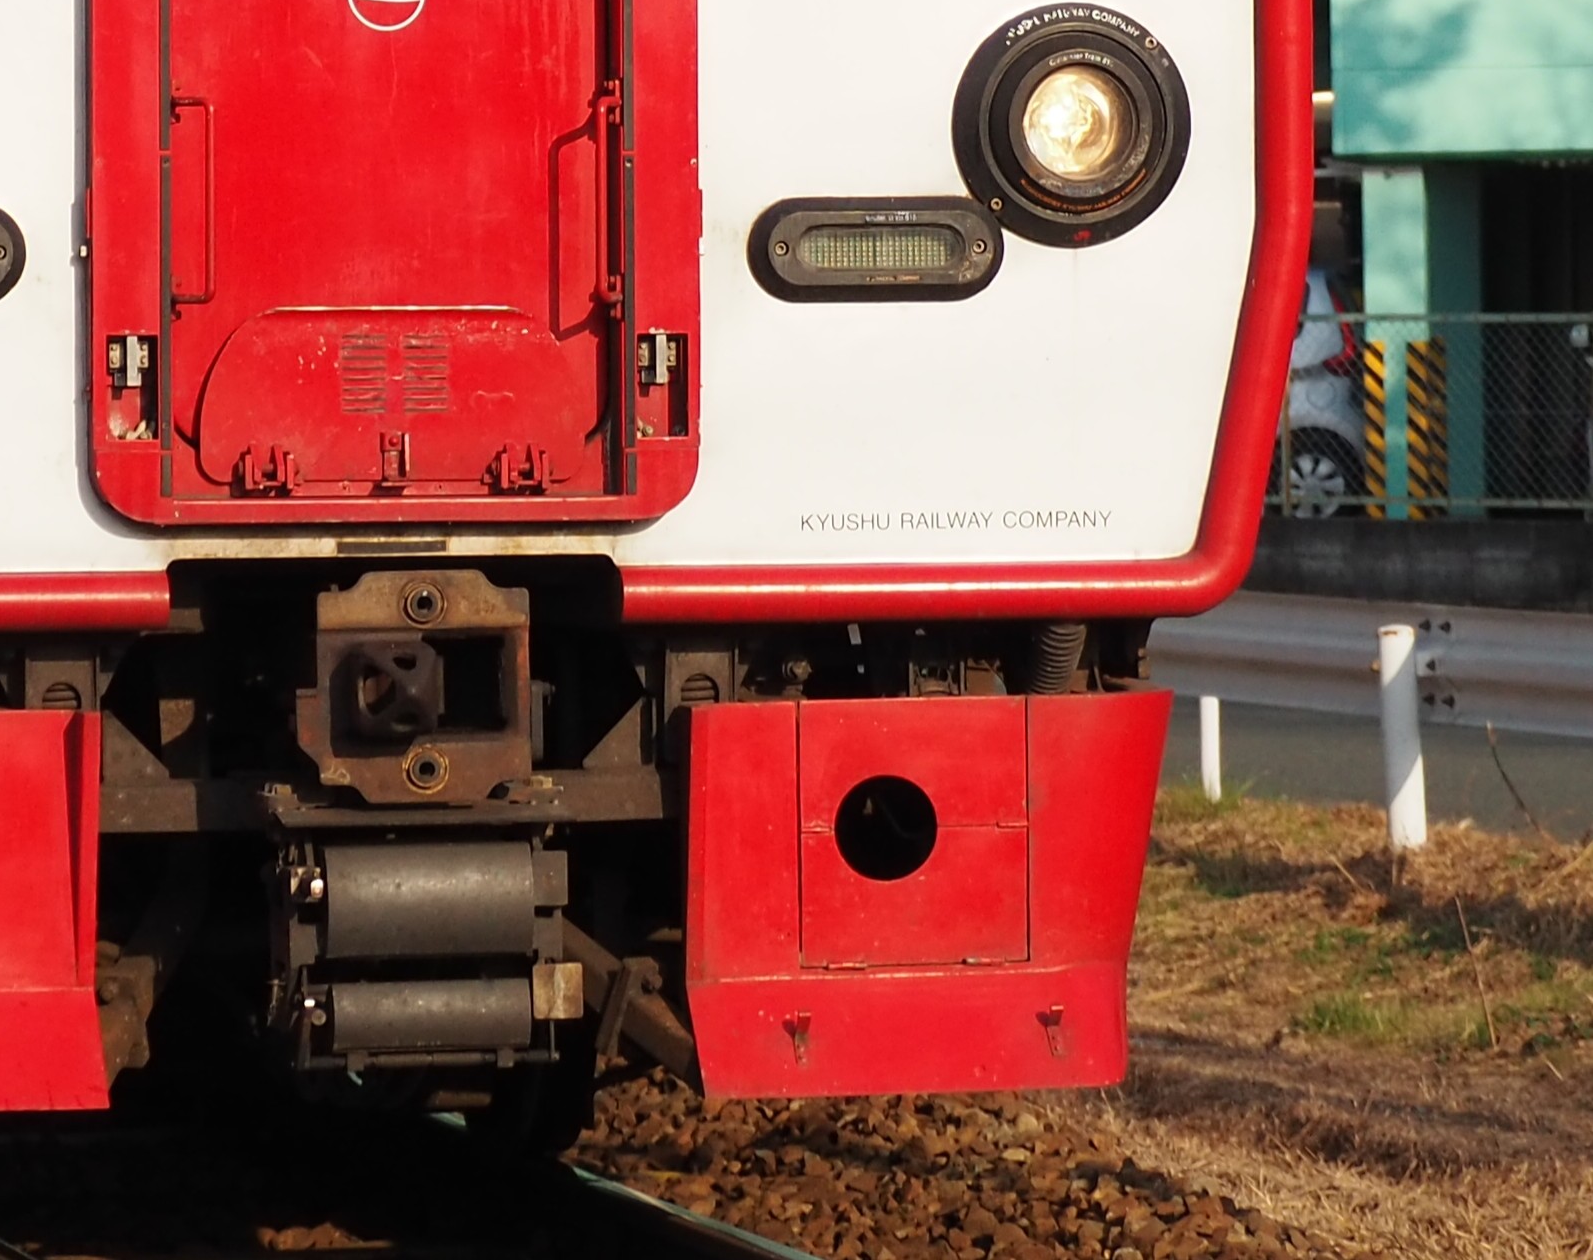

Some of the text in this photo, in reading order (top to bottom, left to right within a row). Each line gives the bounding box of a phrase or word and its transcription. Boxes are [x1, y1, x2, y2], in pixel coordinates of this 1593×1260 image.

[801, 510, 1112, 532] KYUSHU RAILWAY COMPANY
